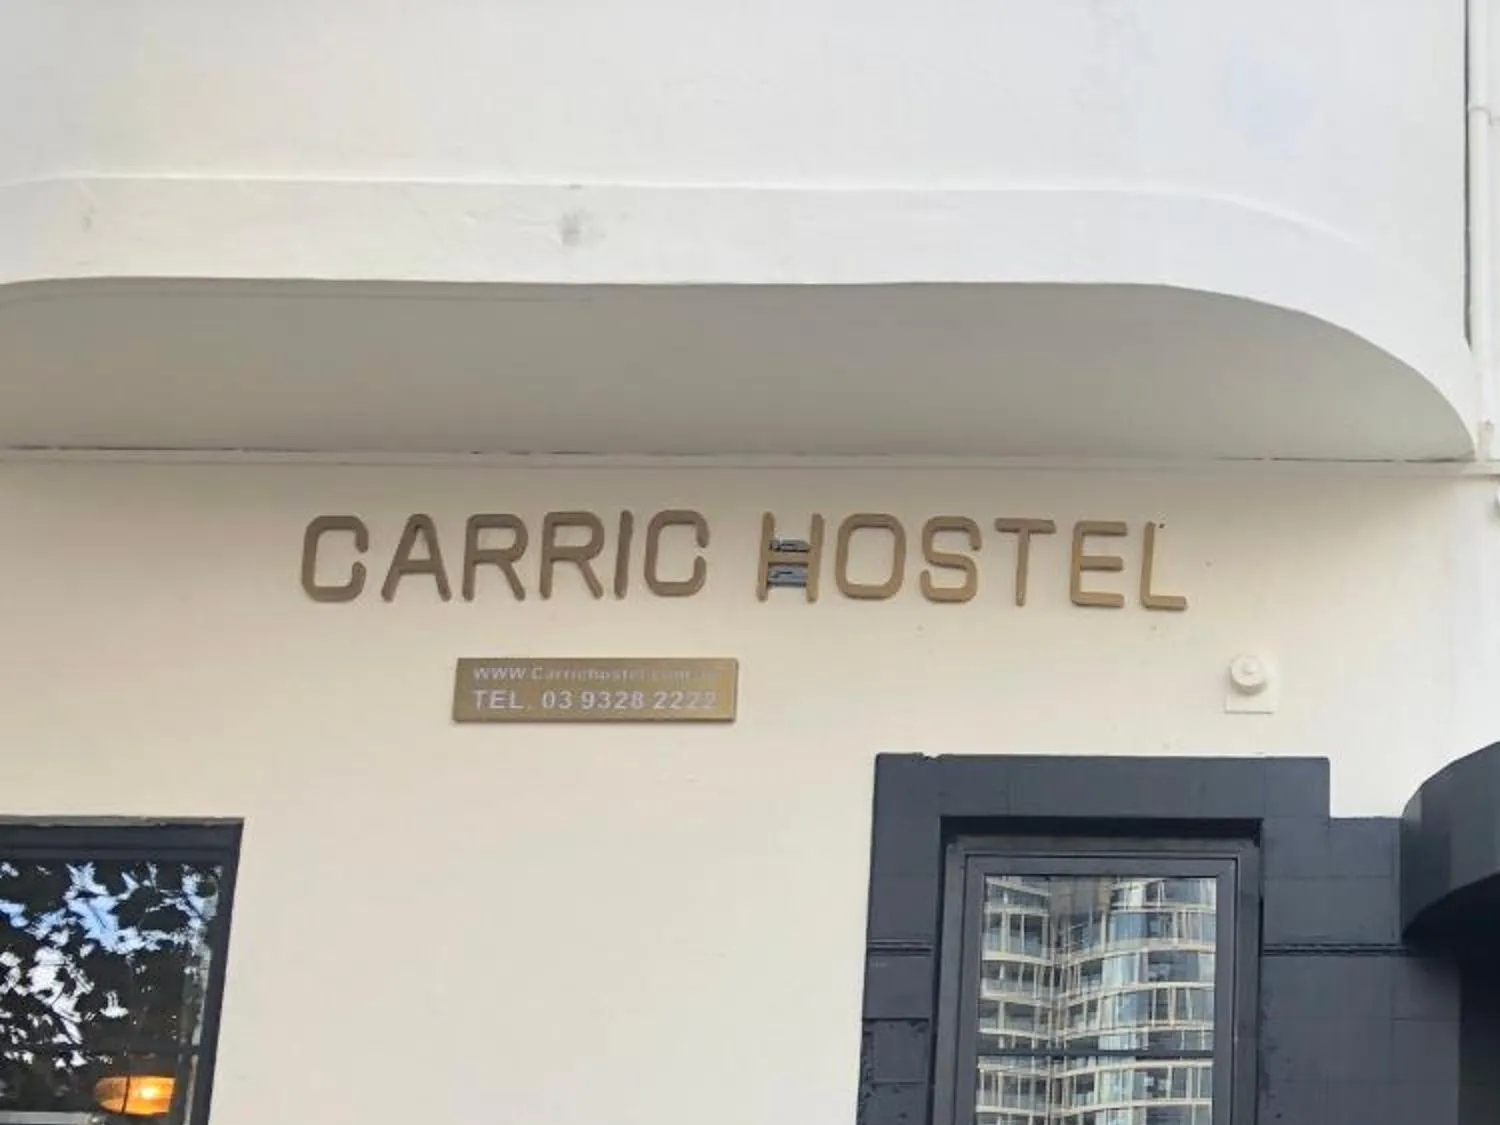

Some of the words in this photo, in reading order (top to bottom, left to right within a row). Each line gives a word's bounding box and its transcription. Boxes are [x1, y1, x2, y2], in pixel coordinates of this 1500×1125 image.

[301, 510, 710, 601] CARRIC
[756, 511, 1188, 611] HOSTEL
[541, 690, 573, 709] 03
[581, 690, 645, 709] 9328
[652, 690, 718, 709] 2222
